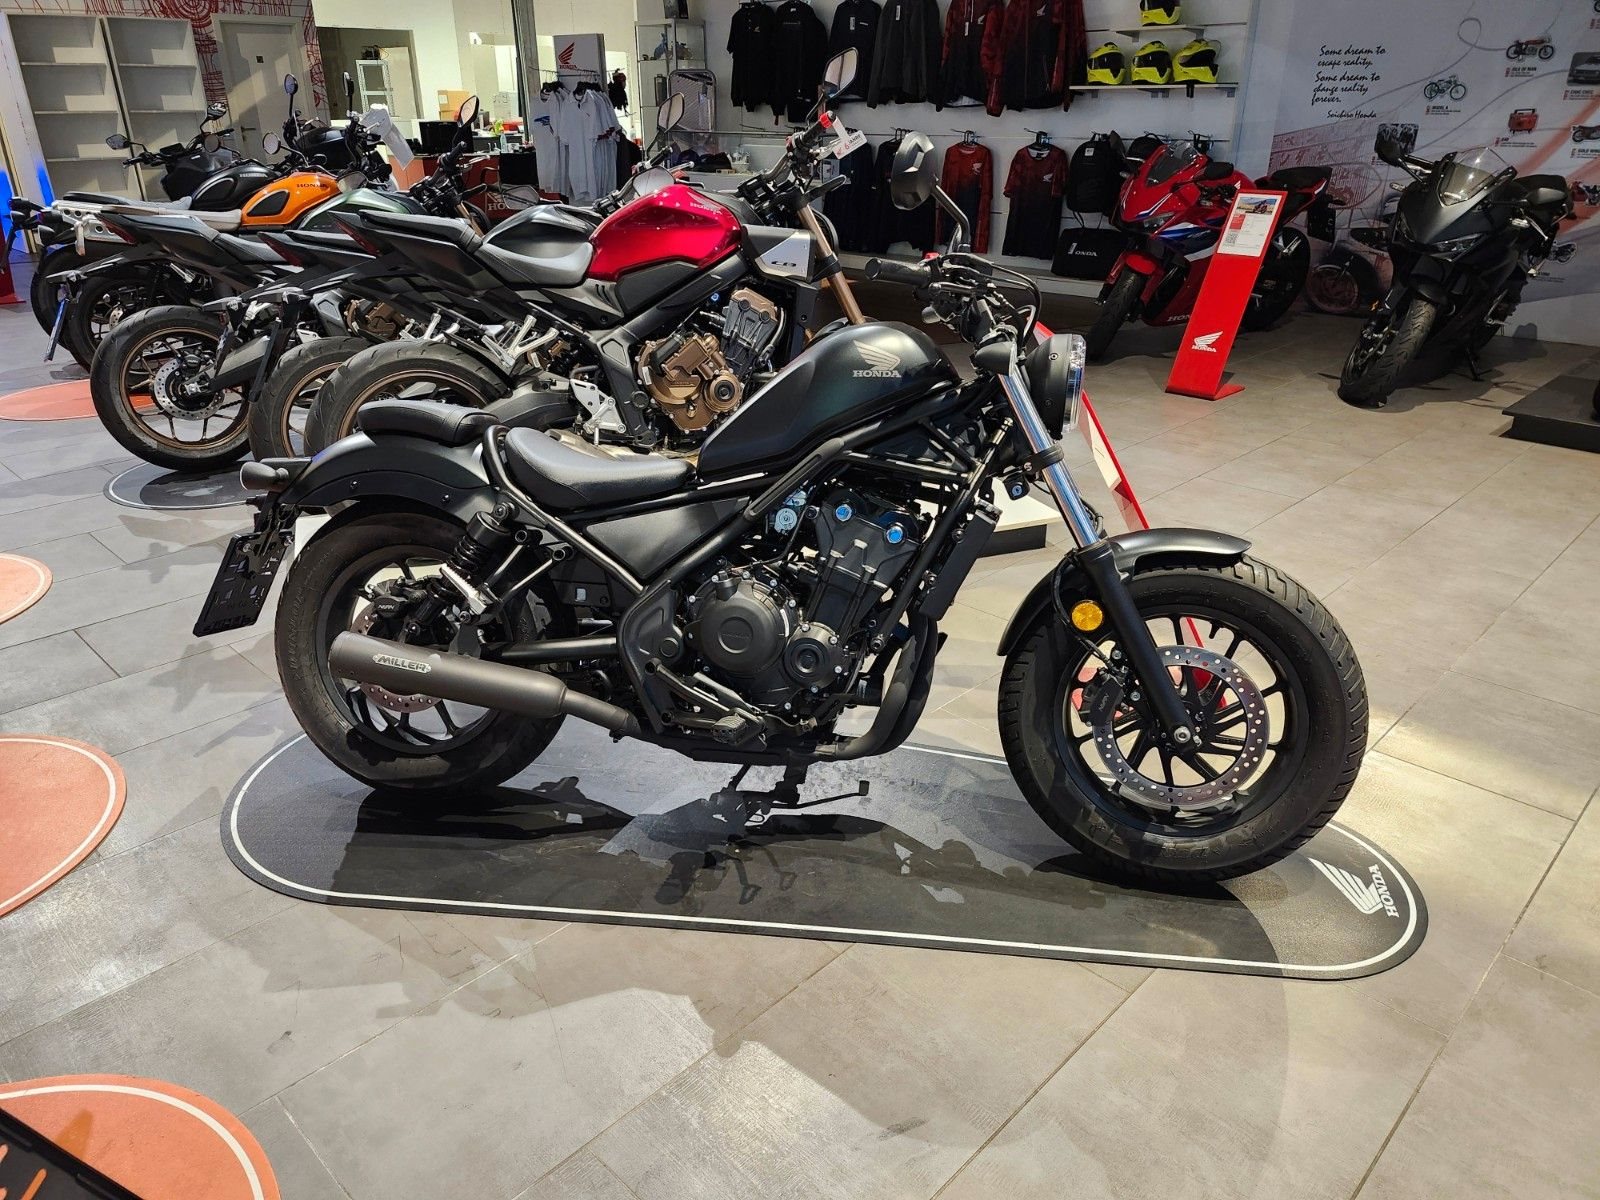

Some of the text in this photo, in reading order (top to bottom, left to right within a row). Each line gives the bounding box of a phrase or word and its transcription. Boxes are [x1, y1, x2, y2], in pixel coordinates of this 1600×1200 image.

[1319, 44, 1386, 56] Some dream to
[1317, 56, 1373, 69] escape reality.
[1315, 71, 1381, 82] Some dream to
[1313, 83, 1368, 96] change reality
[1311, 92, 1341, 106] forever.
[1354, 110, 1377, 118] Honda
[1167, 314, 1192, 322] HON
[1191, 344, 1217, 353] HONDA
[852, 369, 902, 378] HONDA
[377, 655, 427, 672] MILLER
[1367, 863, 1400, 918] HONDA
